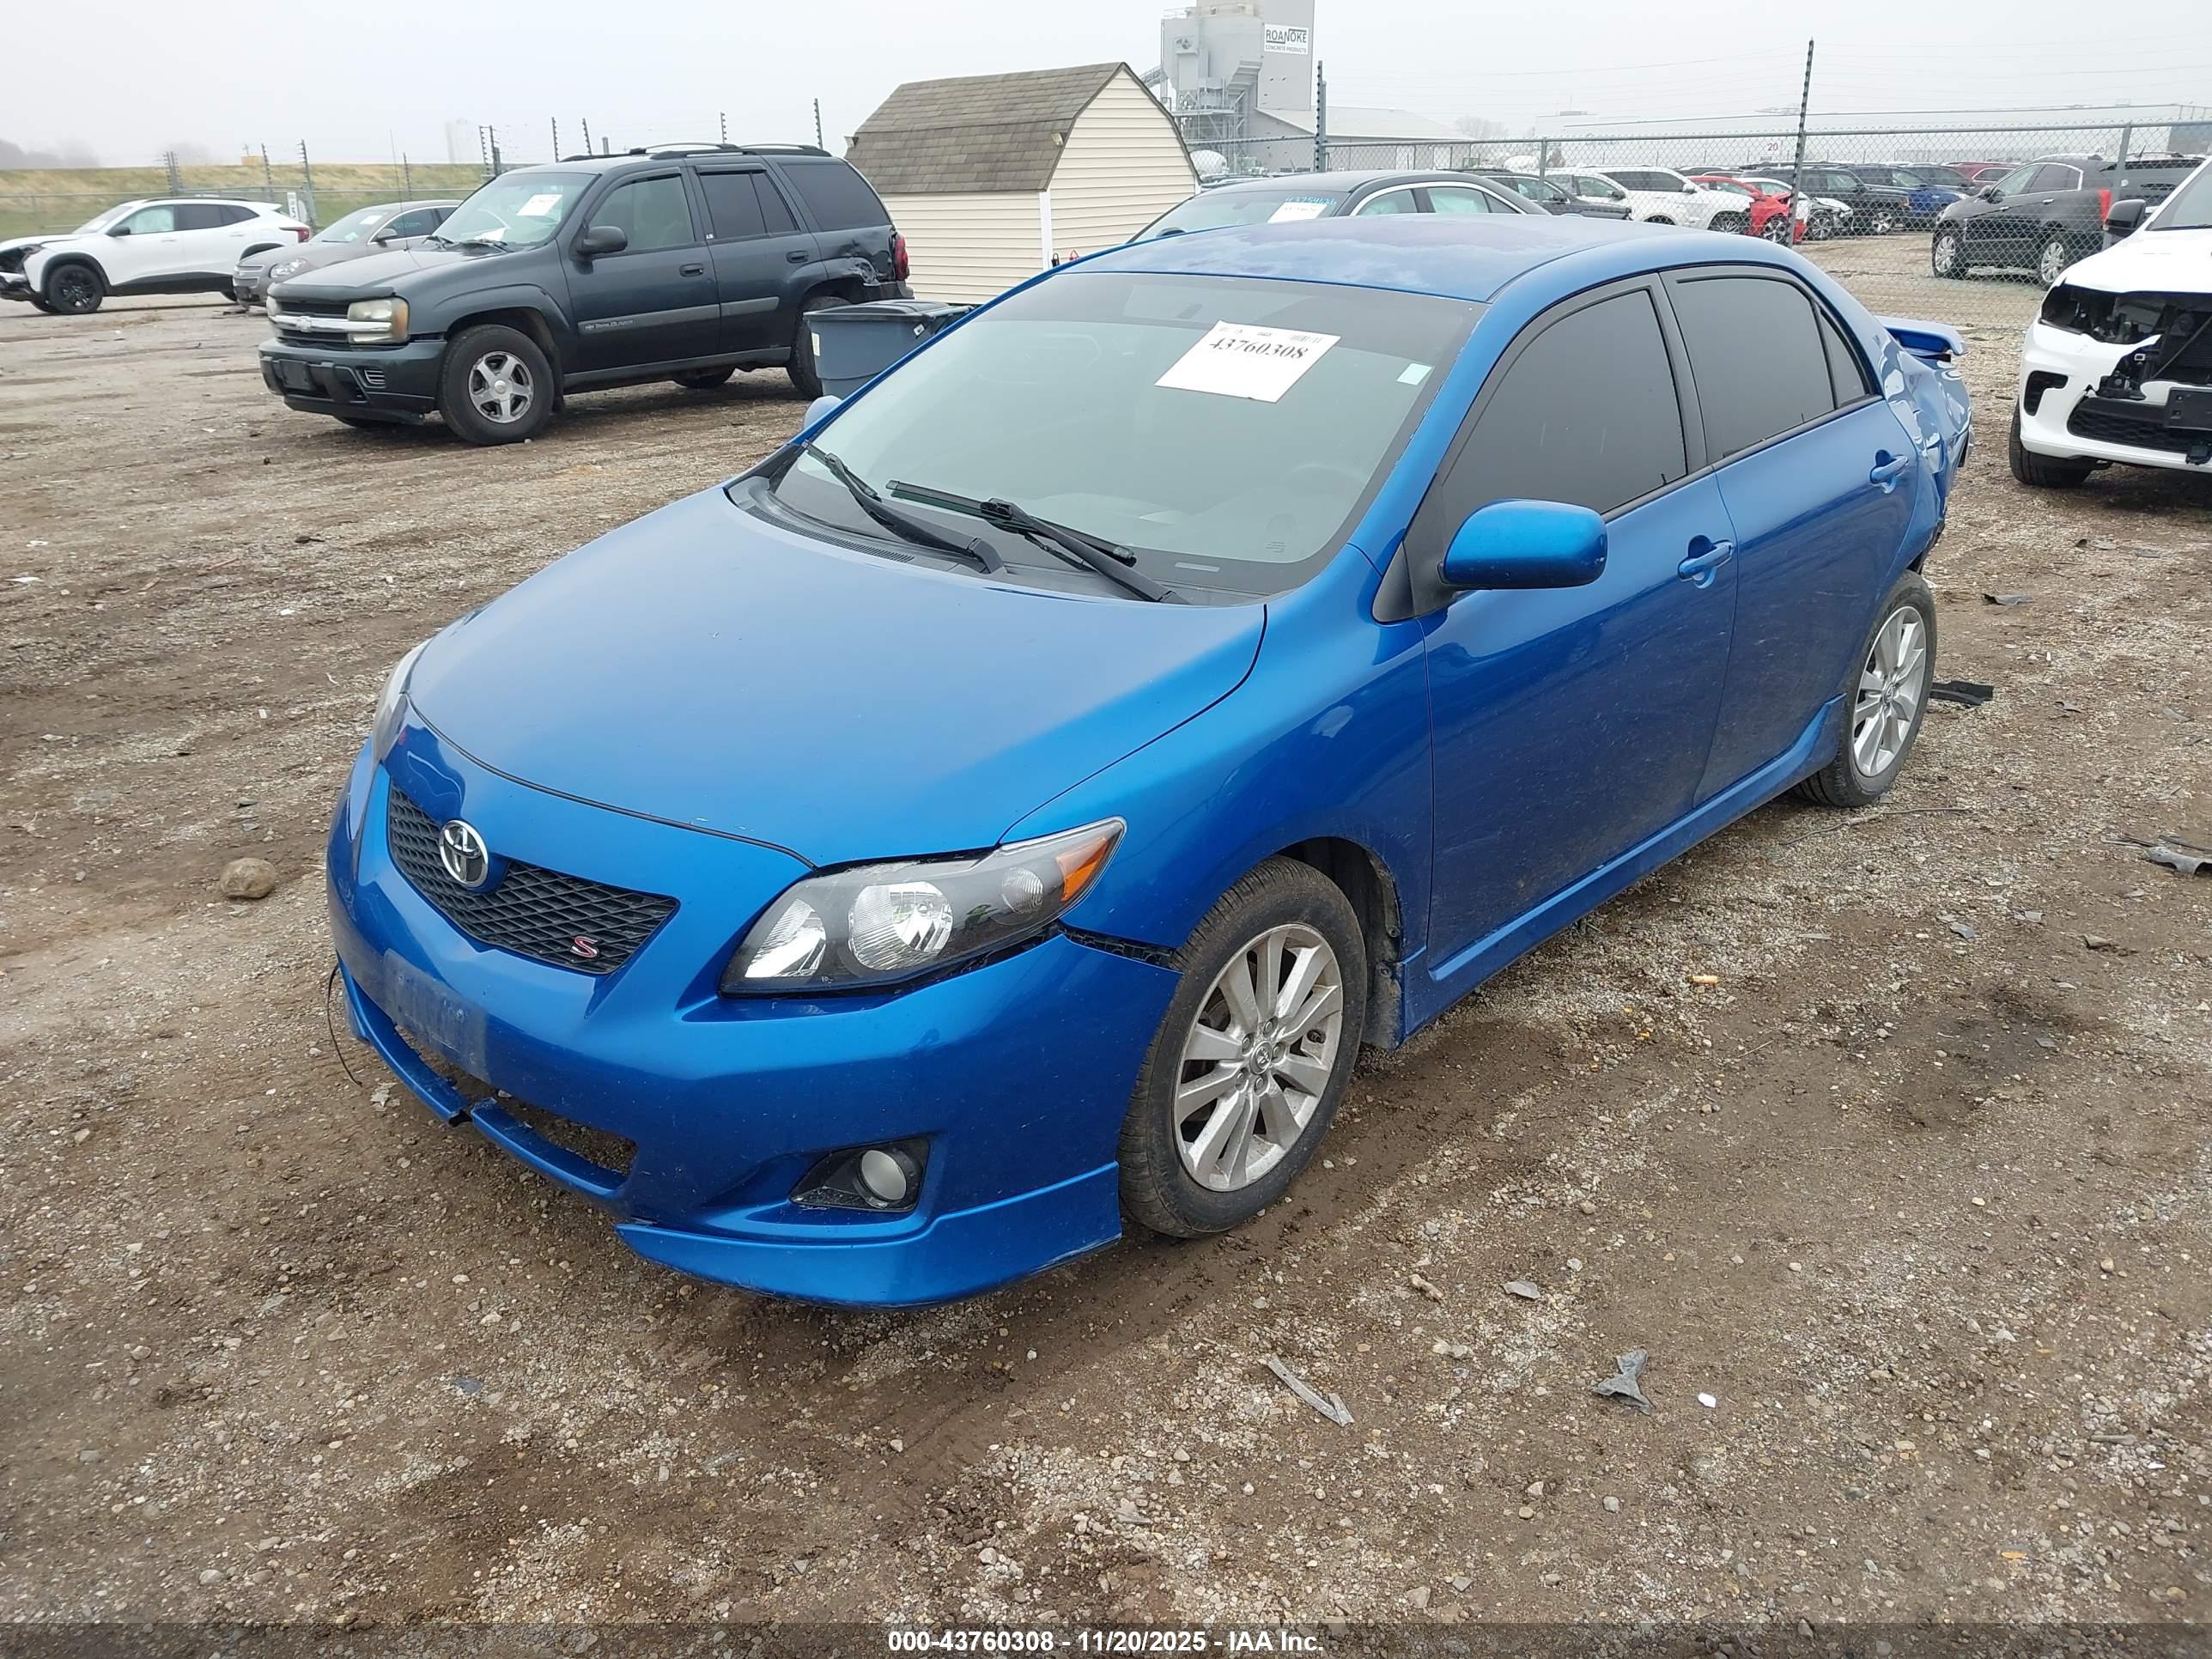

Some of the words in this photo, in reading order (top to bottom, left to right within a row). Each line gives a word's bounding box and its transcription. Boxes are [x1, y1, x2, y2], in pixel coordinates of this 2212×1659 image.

[1266, 28, 1307, 43] ROANOKE
[1767, 143, 1778, 151] 20
[1208, 337, 1309, 359] 43760308
[570, 936, 599, 958] S
